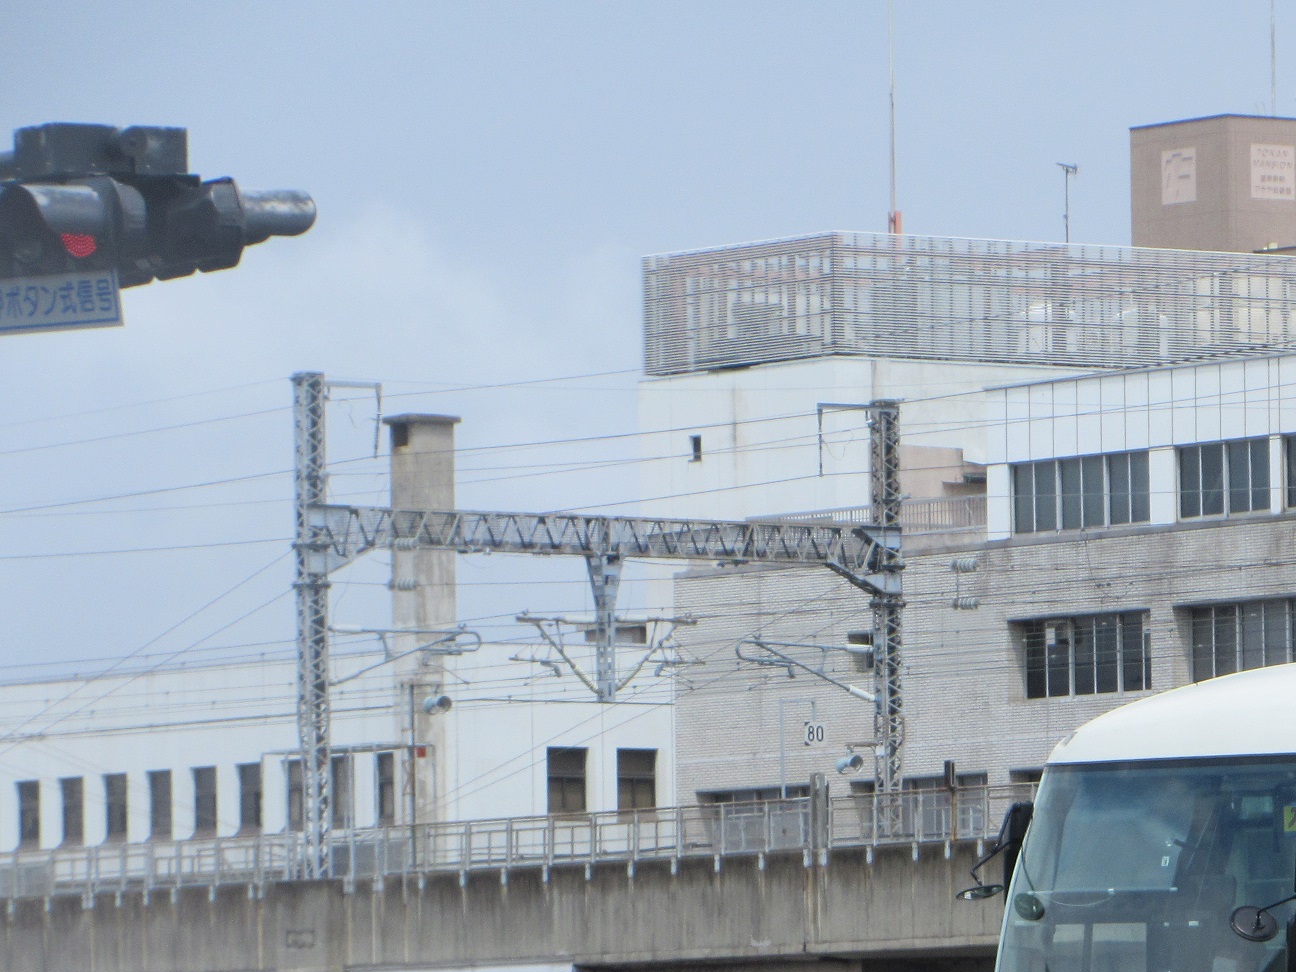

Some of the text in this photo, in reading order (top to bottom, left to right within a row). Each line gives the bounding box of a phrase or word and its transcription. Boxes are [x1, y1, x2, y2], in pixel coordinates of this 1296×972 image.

[0, 279, 112, 317] ボタン式信号
[808, 726, 823, 741] 80
